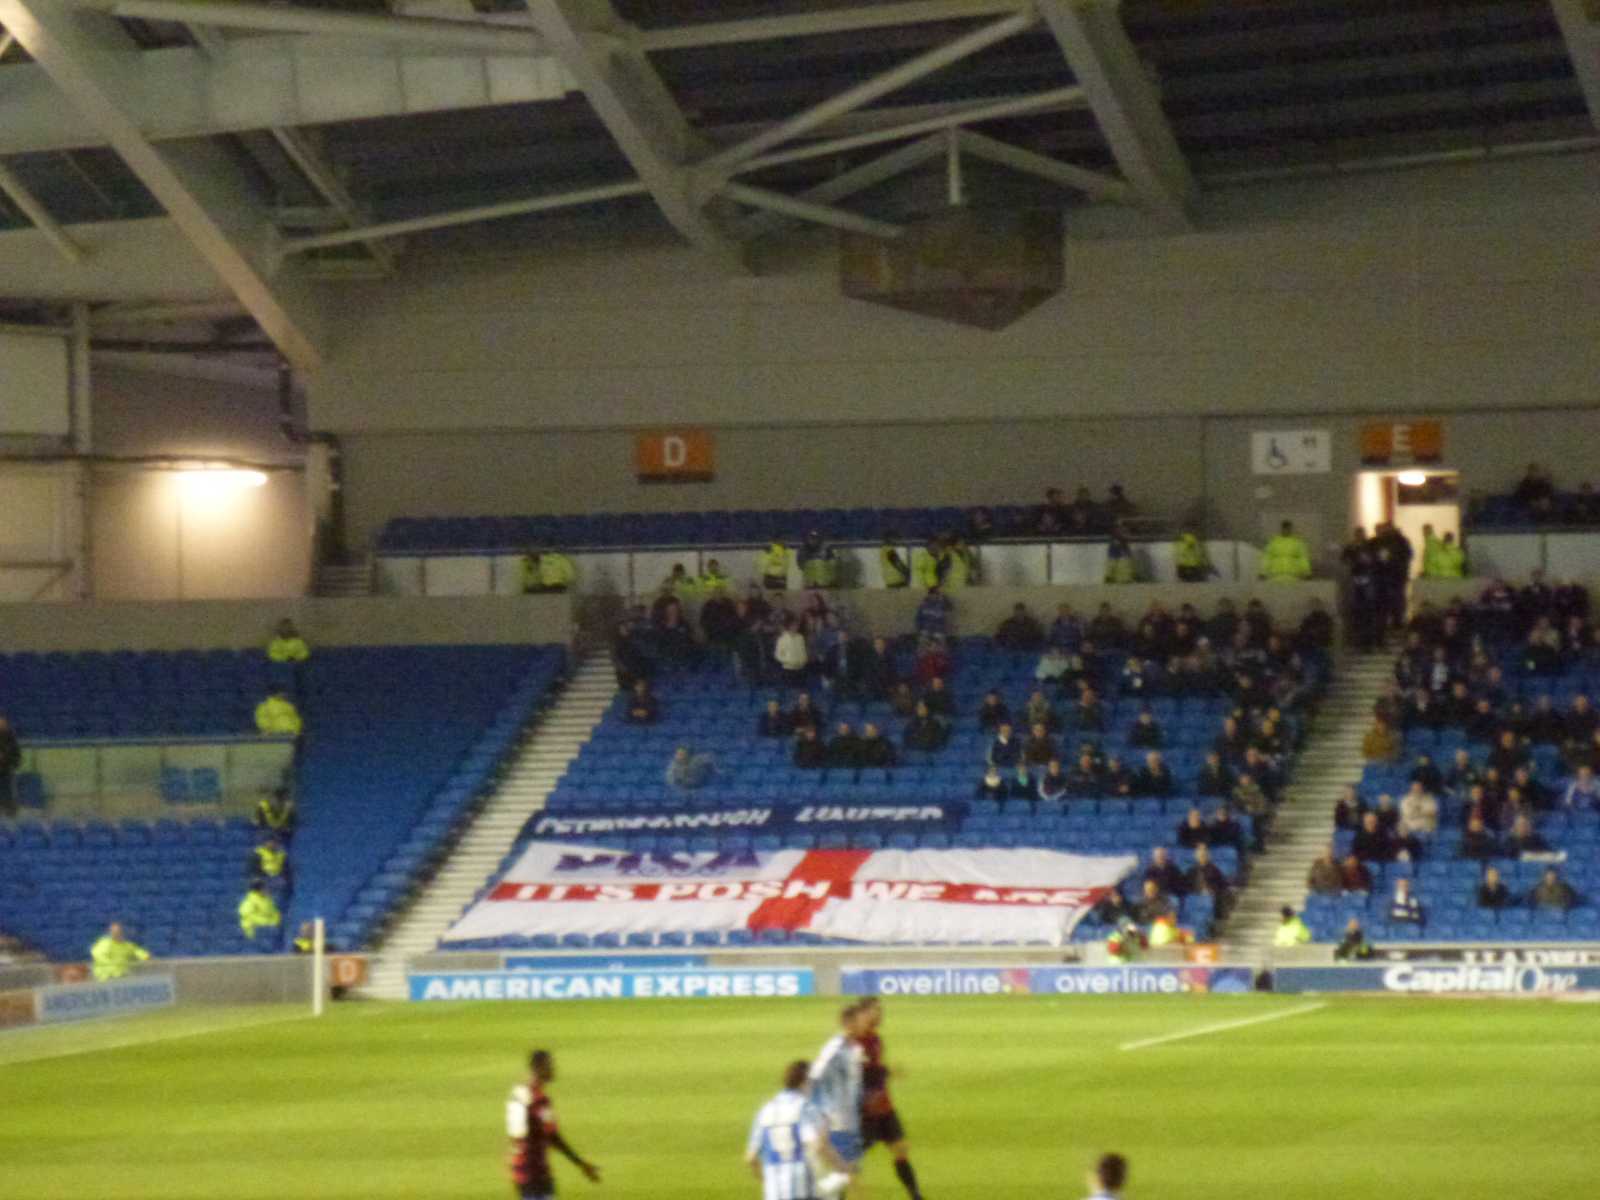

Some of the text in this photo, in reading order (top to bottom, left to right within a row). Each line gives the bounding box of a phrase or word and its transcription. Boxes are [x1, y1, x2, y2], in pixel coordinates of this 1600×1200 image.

[663, 436, 687, 468] D
[655, 880, 832, 901] POSH
[864, 881, 946, 901] WE
[423, 974, 800, 1000] AMERICAN EXPRESS
